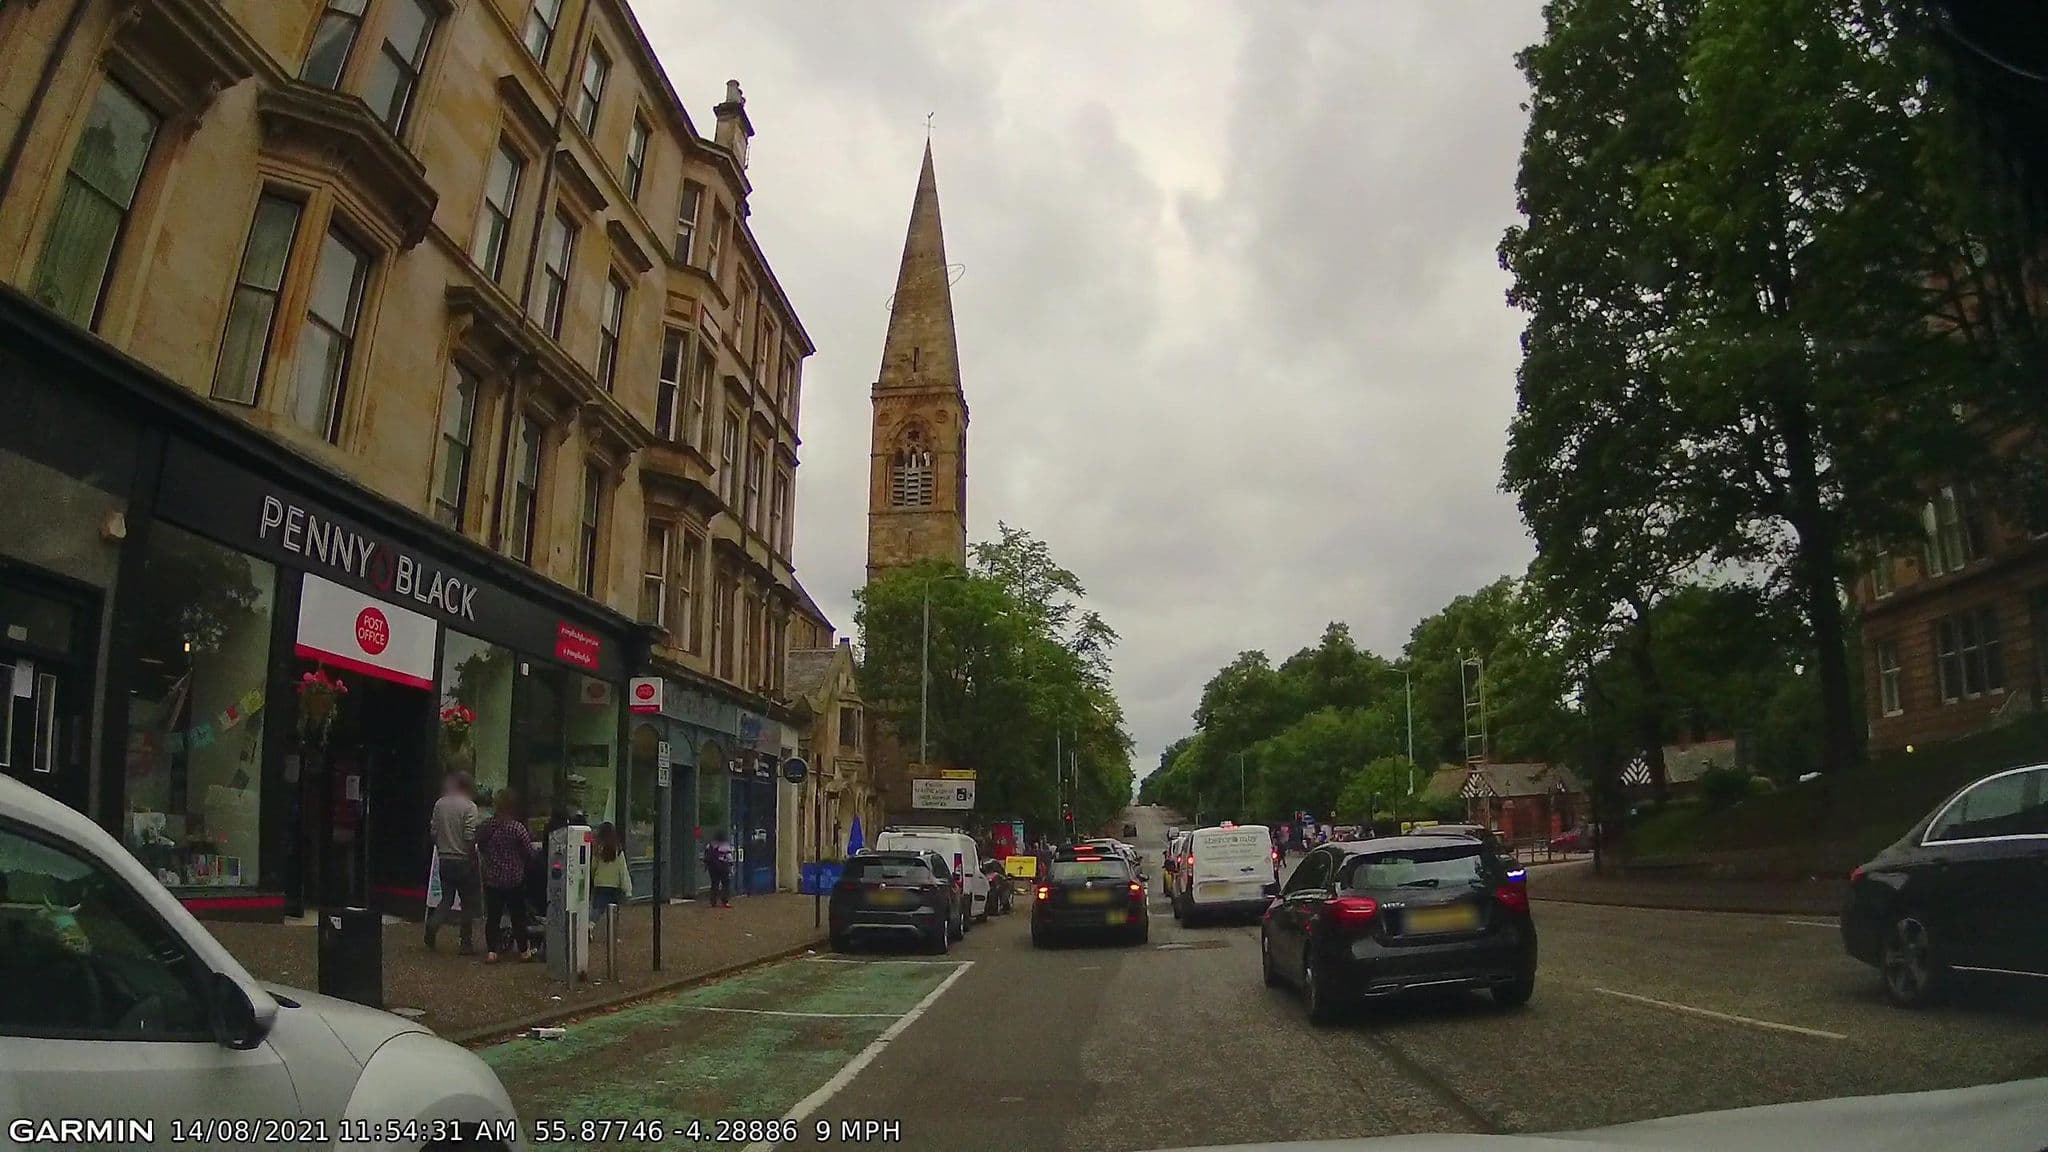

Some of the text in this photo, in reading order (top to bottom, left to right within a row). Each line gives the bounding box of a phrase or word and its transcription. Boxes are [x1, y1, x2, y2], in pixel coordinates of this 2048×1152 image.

[260, 495, 478, 621] PENNY BLACK
[364, 615, 384, 632] POST
[358, 628, 385, 646] OFFICE
